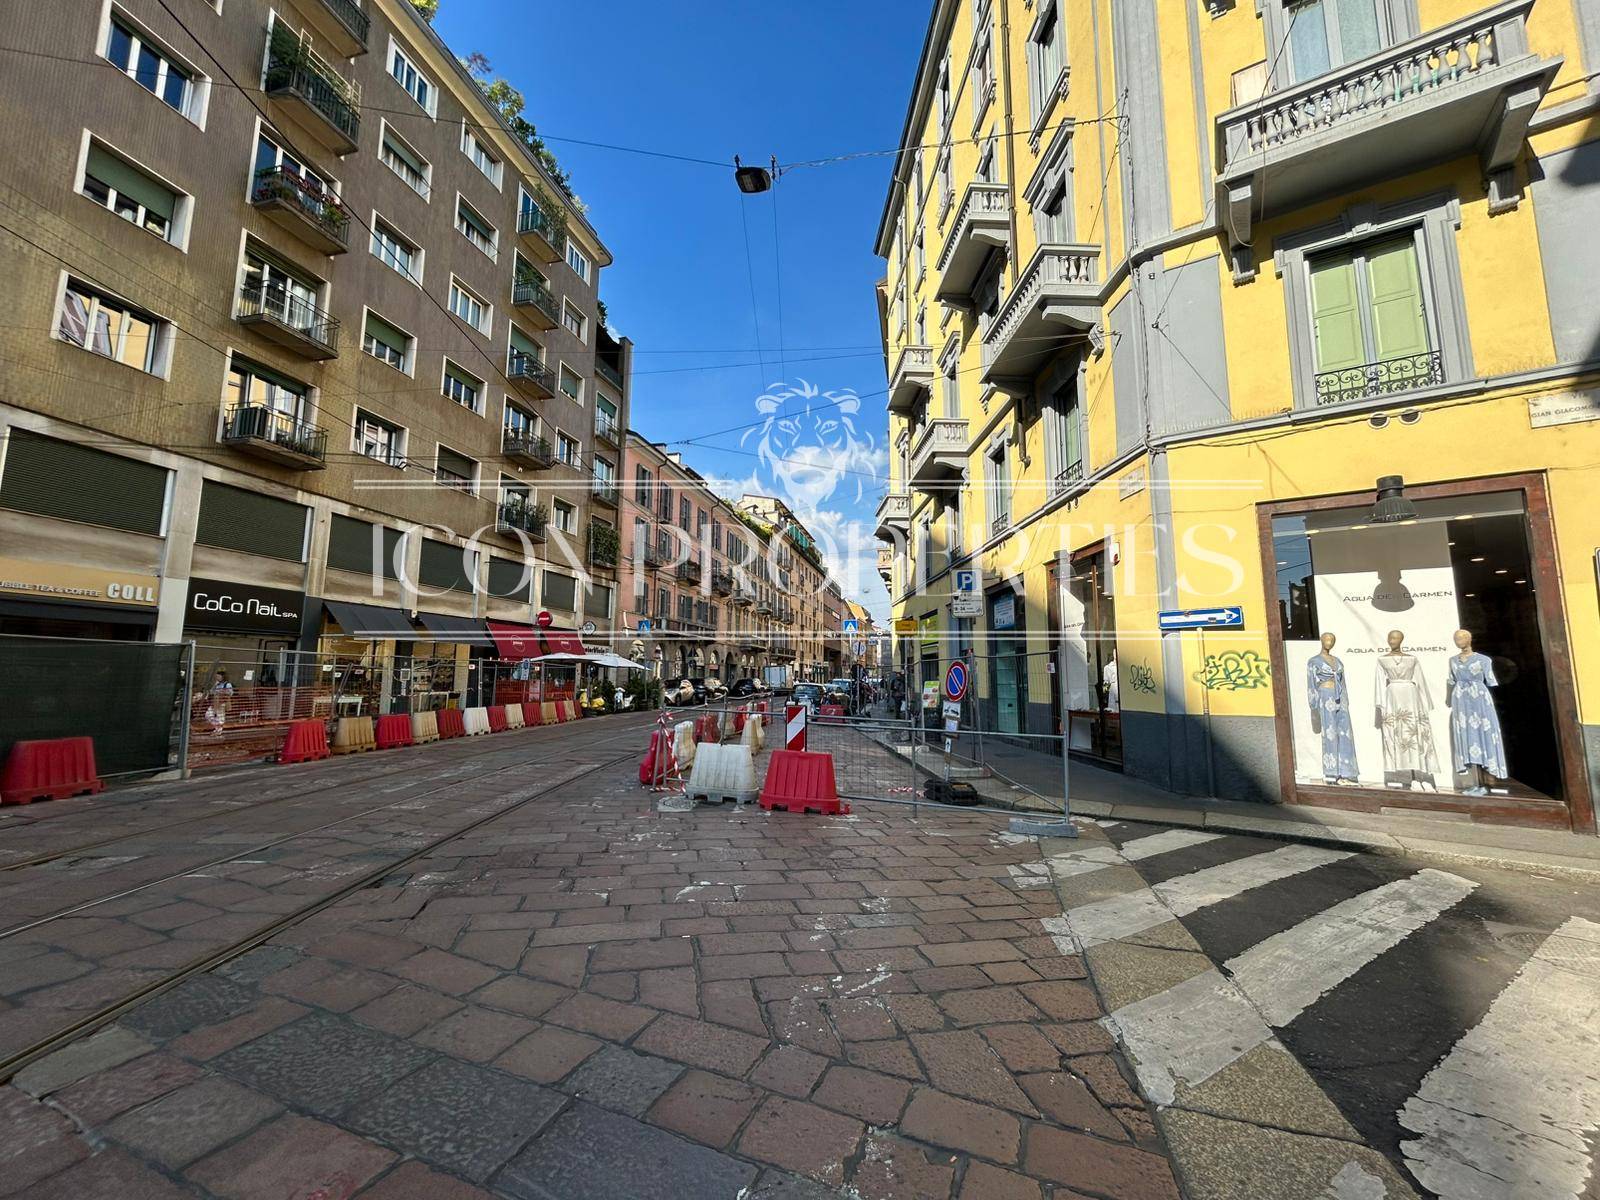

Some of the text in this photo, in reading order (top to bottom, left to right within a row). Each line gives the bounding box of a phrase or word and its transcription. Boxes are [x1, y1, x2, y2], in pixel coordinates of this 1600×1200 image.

[1554, 405, 1595, 415] GIACOMO
[961, 573, 972, 589] P
[1403, 591, 1453, 599] CARMEN
